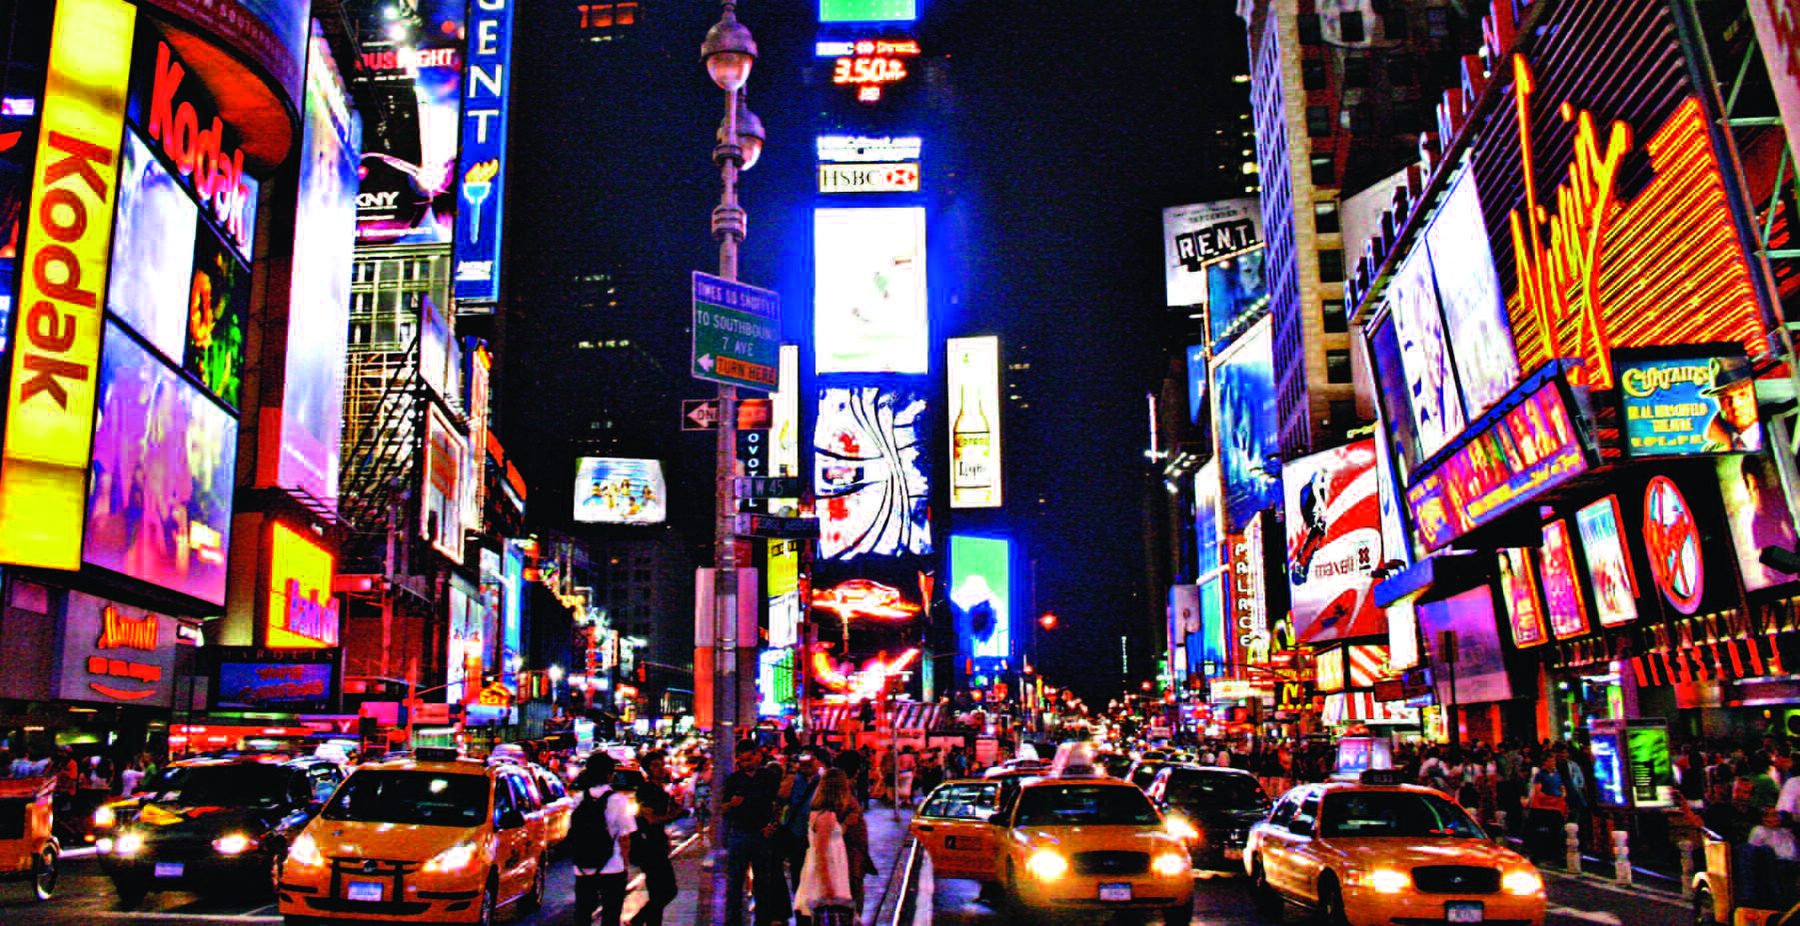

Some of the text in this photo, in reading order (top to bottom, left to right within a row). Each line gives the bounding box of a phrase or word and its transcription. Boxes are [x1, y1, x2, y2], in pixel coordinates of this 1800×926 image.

[466, 0, 505, 144] ENT
[148, 41, 250, 248] Kodak
[822, 169, 881, 186] HSBC
[19, 130, 112, 412] Kodak
[697, 282, 722, 301] TIMES
[697, 310, 710, 326] TO
[721, 336, 754, 357] 7 AVE
[717, 357, 777, 385] TURN HERE
[755, 479, 784, 496] W 45
[1235, 543, 1254, 647] PALACE
